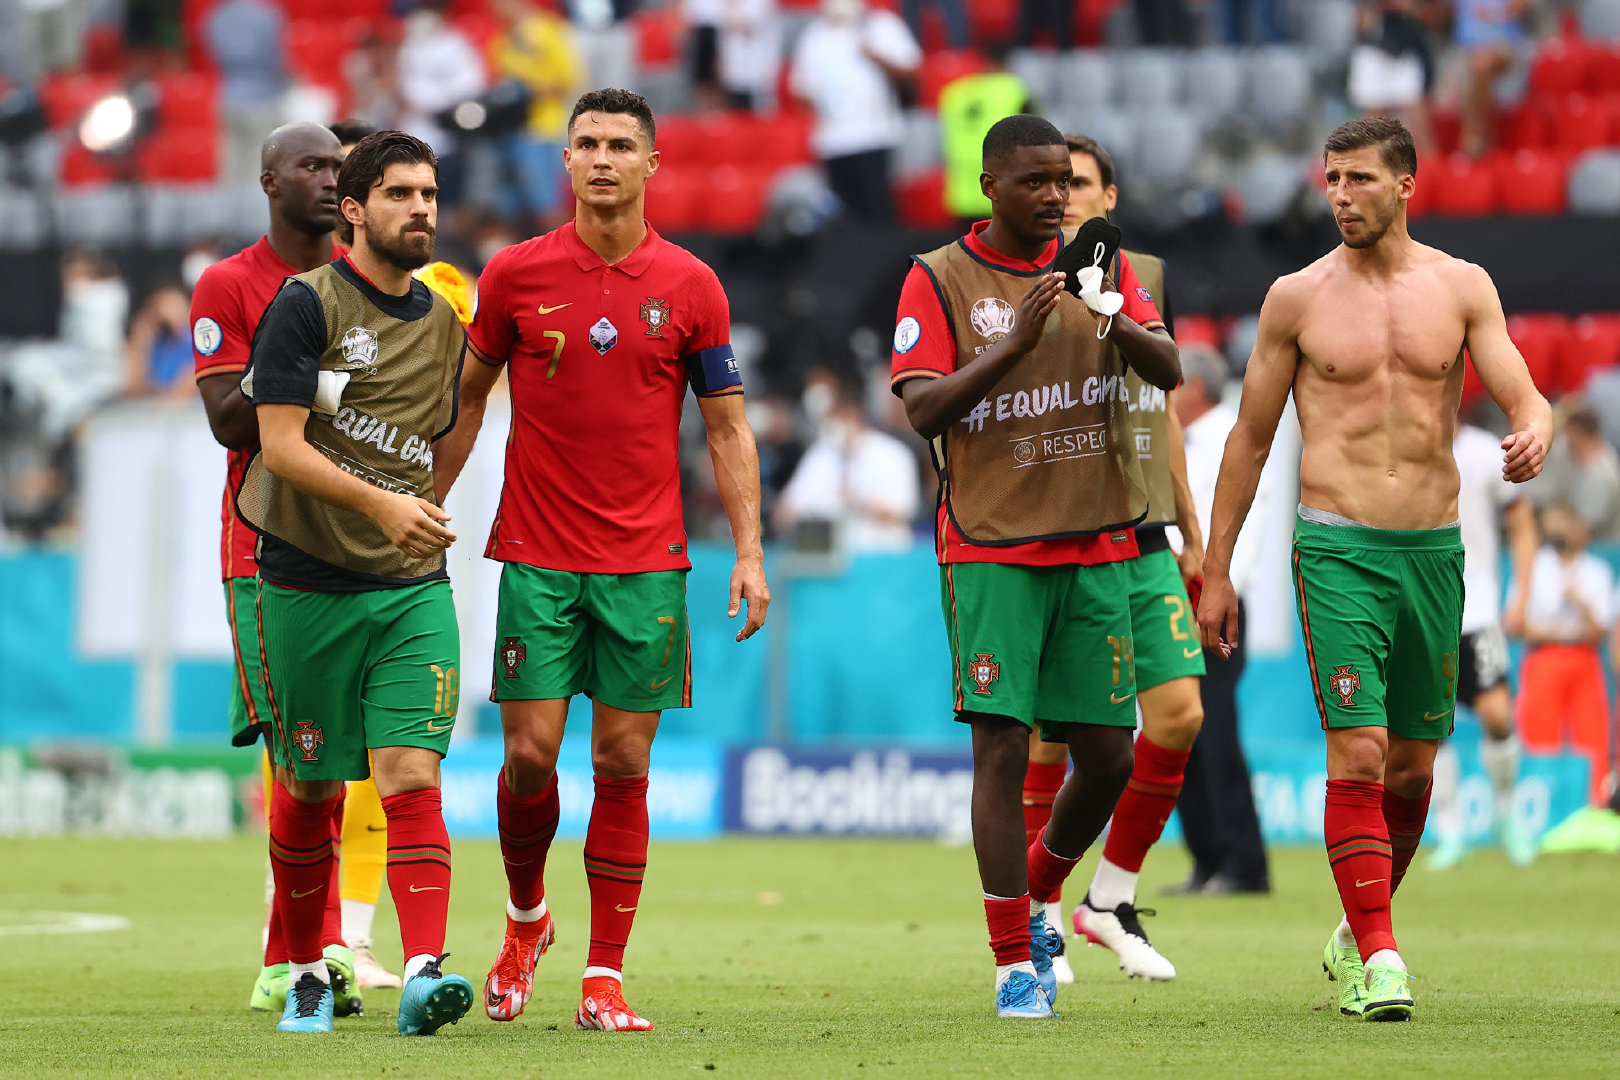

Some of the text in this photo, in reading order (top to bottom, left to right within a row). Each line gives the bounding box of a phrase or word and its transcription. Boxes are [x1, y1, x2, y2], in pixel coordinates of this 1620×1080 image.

[543, 330, 566, 379] 7
[331, 406, 399, 454] QUAL
[1042, 429, 1106, 456] RESPEC
[657, 615, 676, 667] 7
[1107, 635, 1134, 686] 14
[430, 664, 458, 718] 18
[1442, 650, 1457, 699] 4
